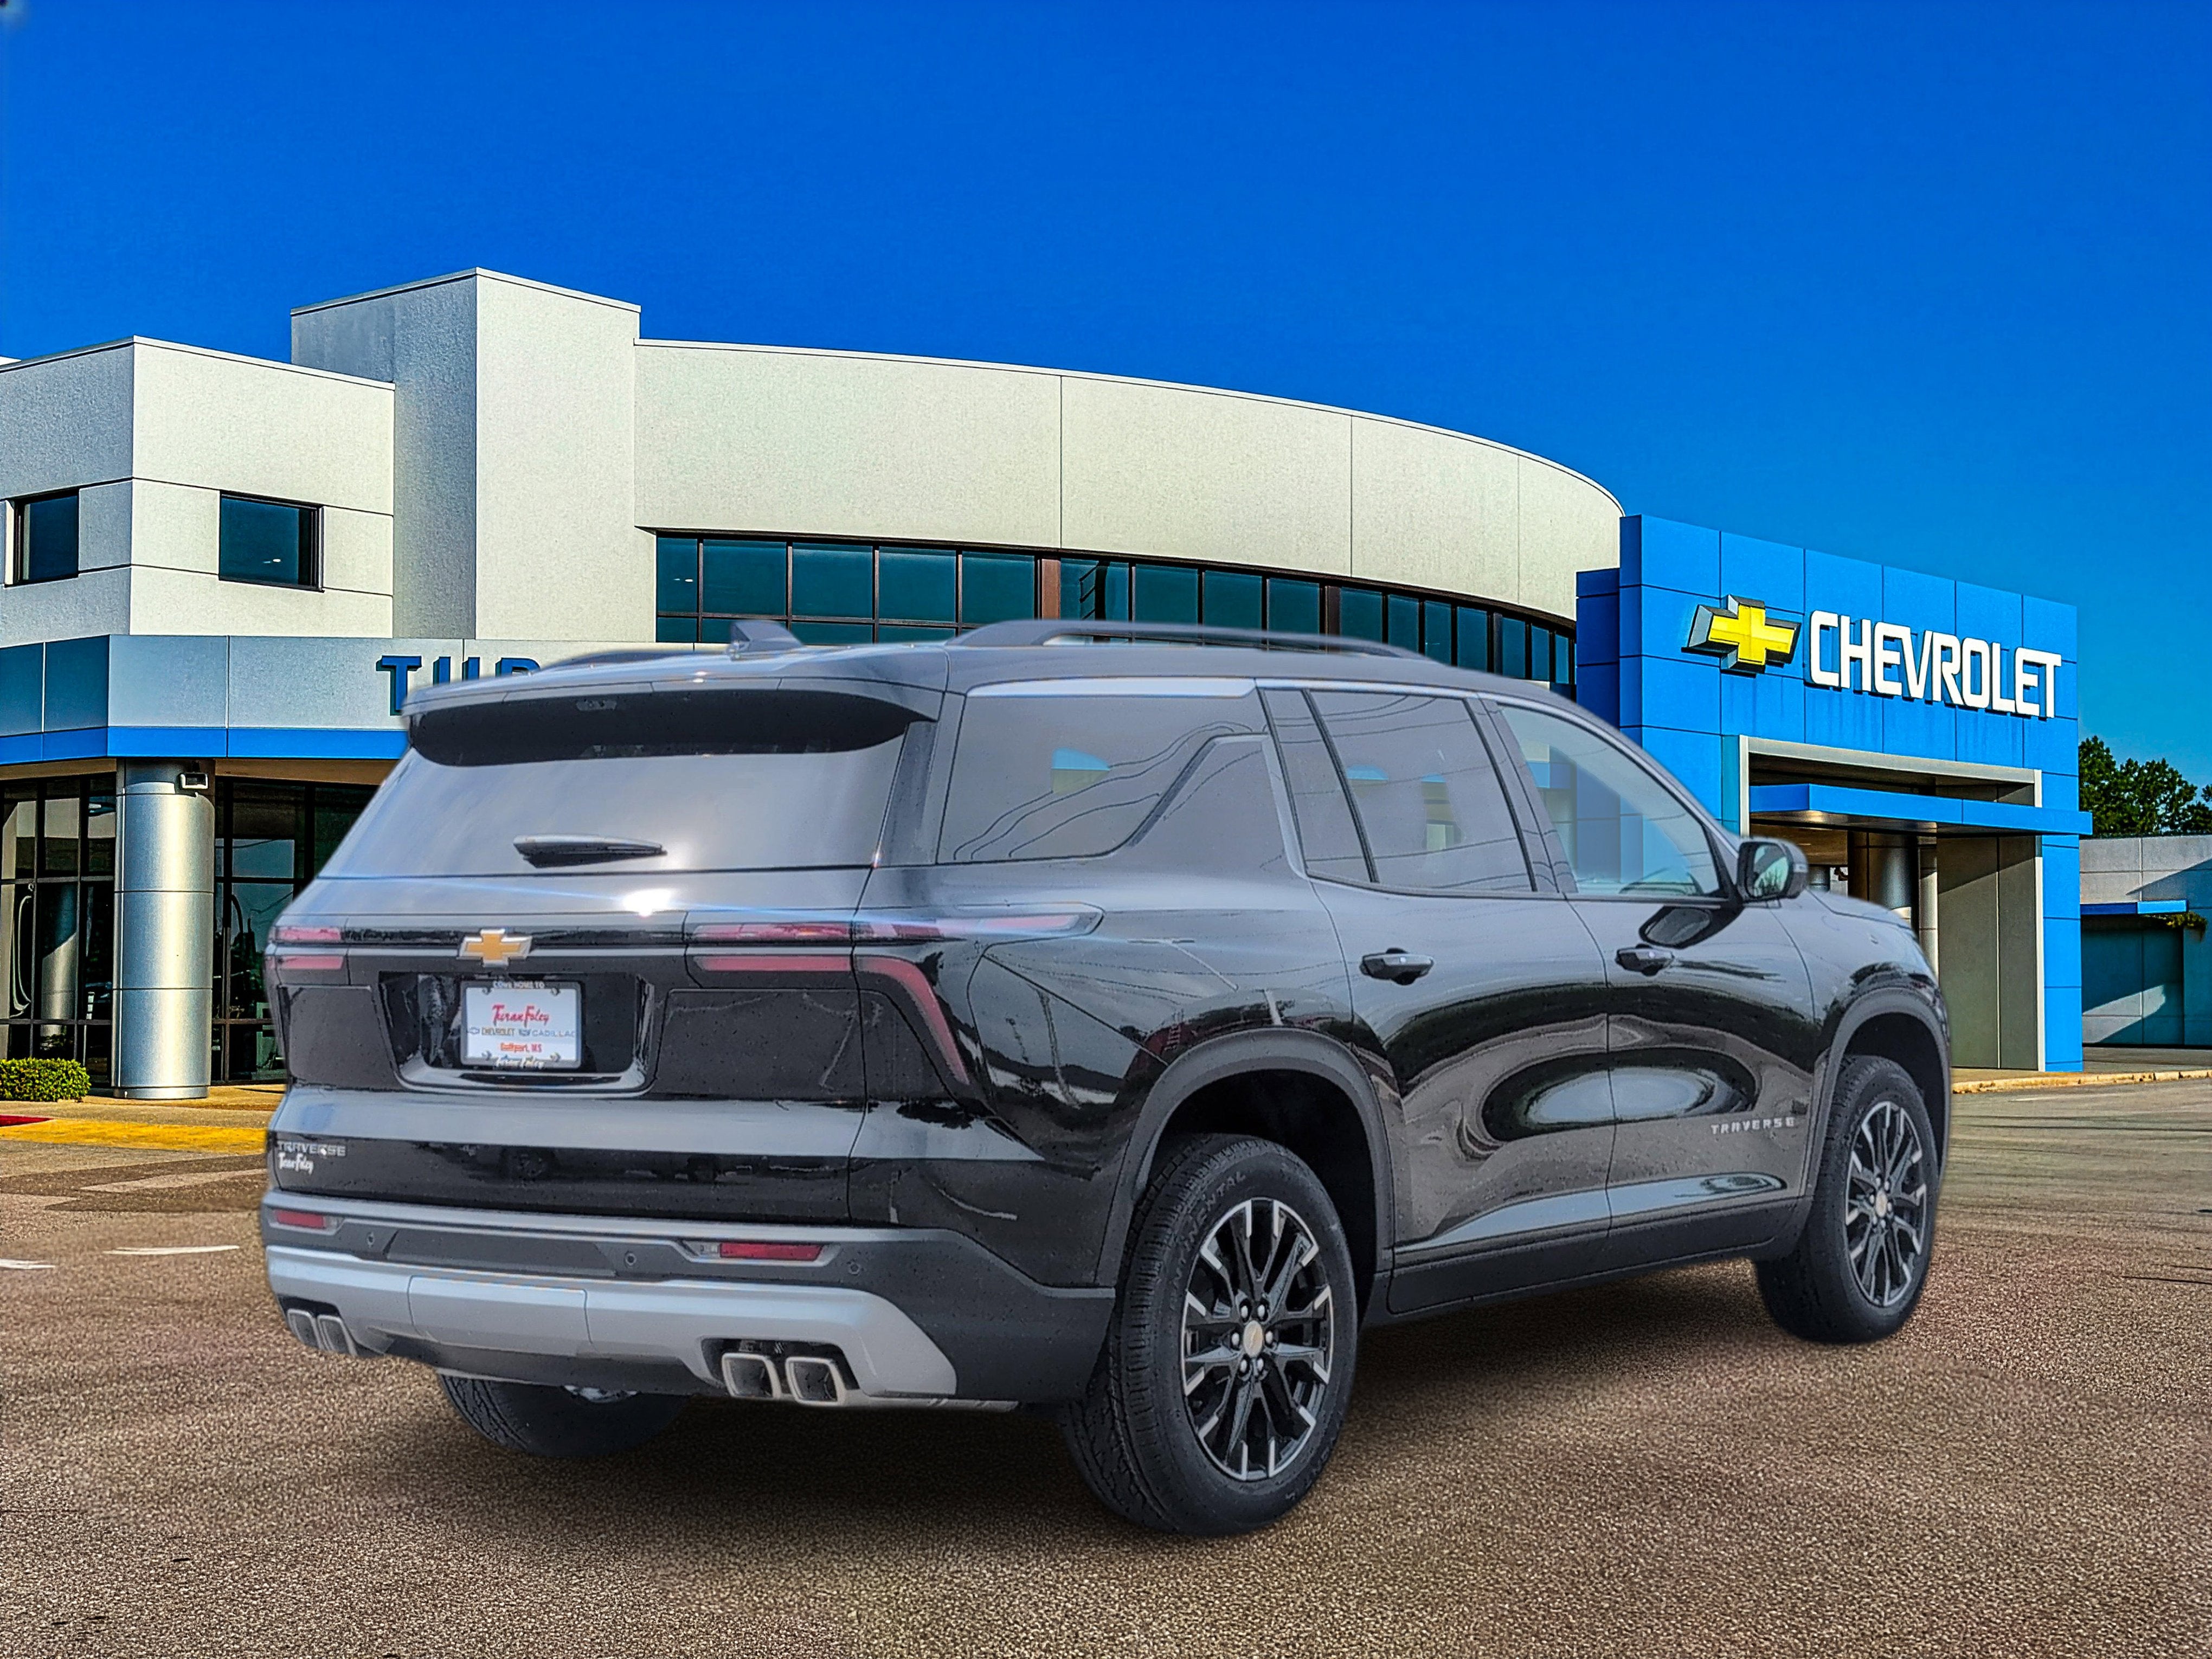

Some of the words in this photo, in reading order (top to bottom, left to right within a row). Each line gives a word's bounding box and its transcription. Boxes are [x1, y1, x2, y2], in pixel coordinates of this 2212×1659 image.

[1809, 609, 2062, 719] CHEVROLET
[532, 1029, 575, 1037] CADILLAC
[1711, 1116, 1795, 1135] TRAVERSE
[277, 1140, 346, 1157] TRAVERSE
[1169, 1171, 1246, 1312] ONTINENTAL
